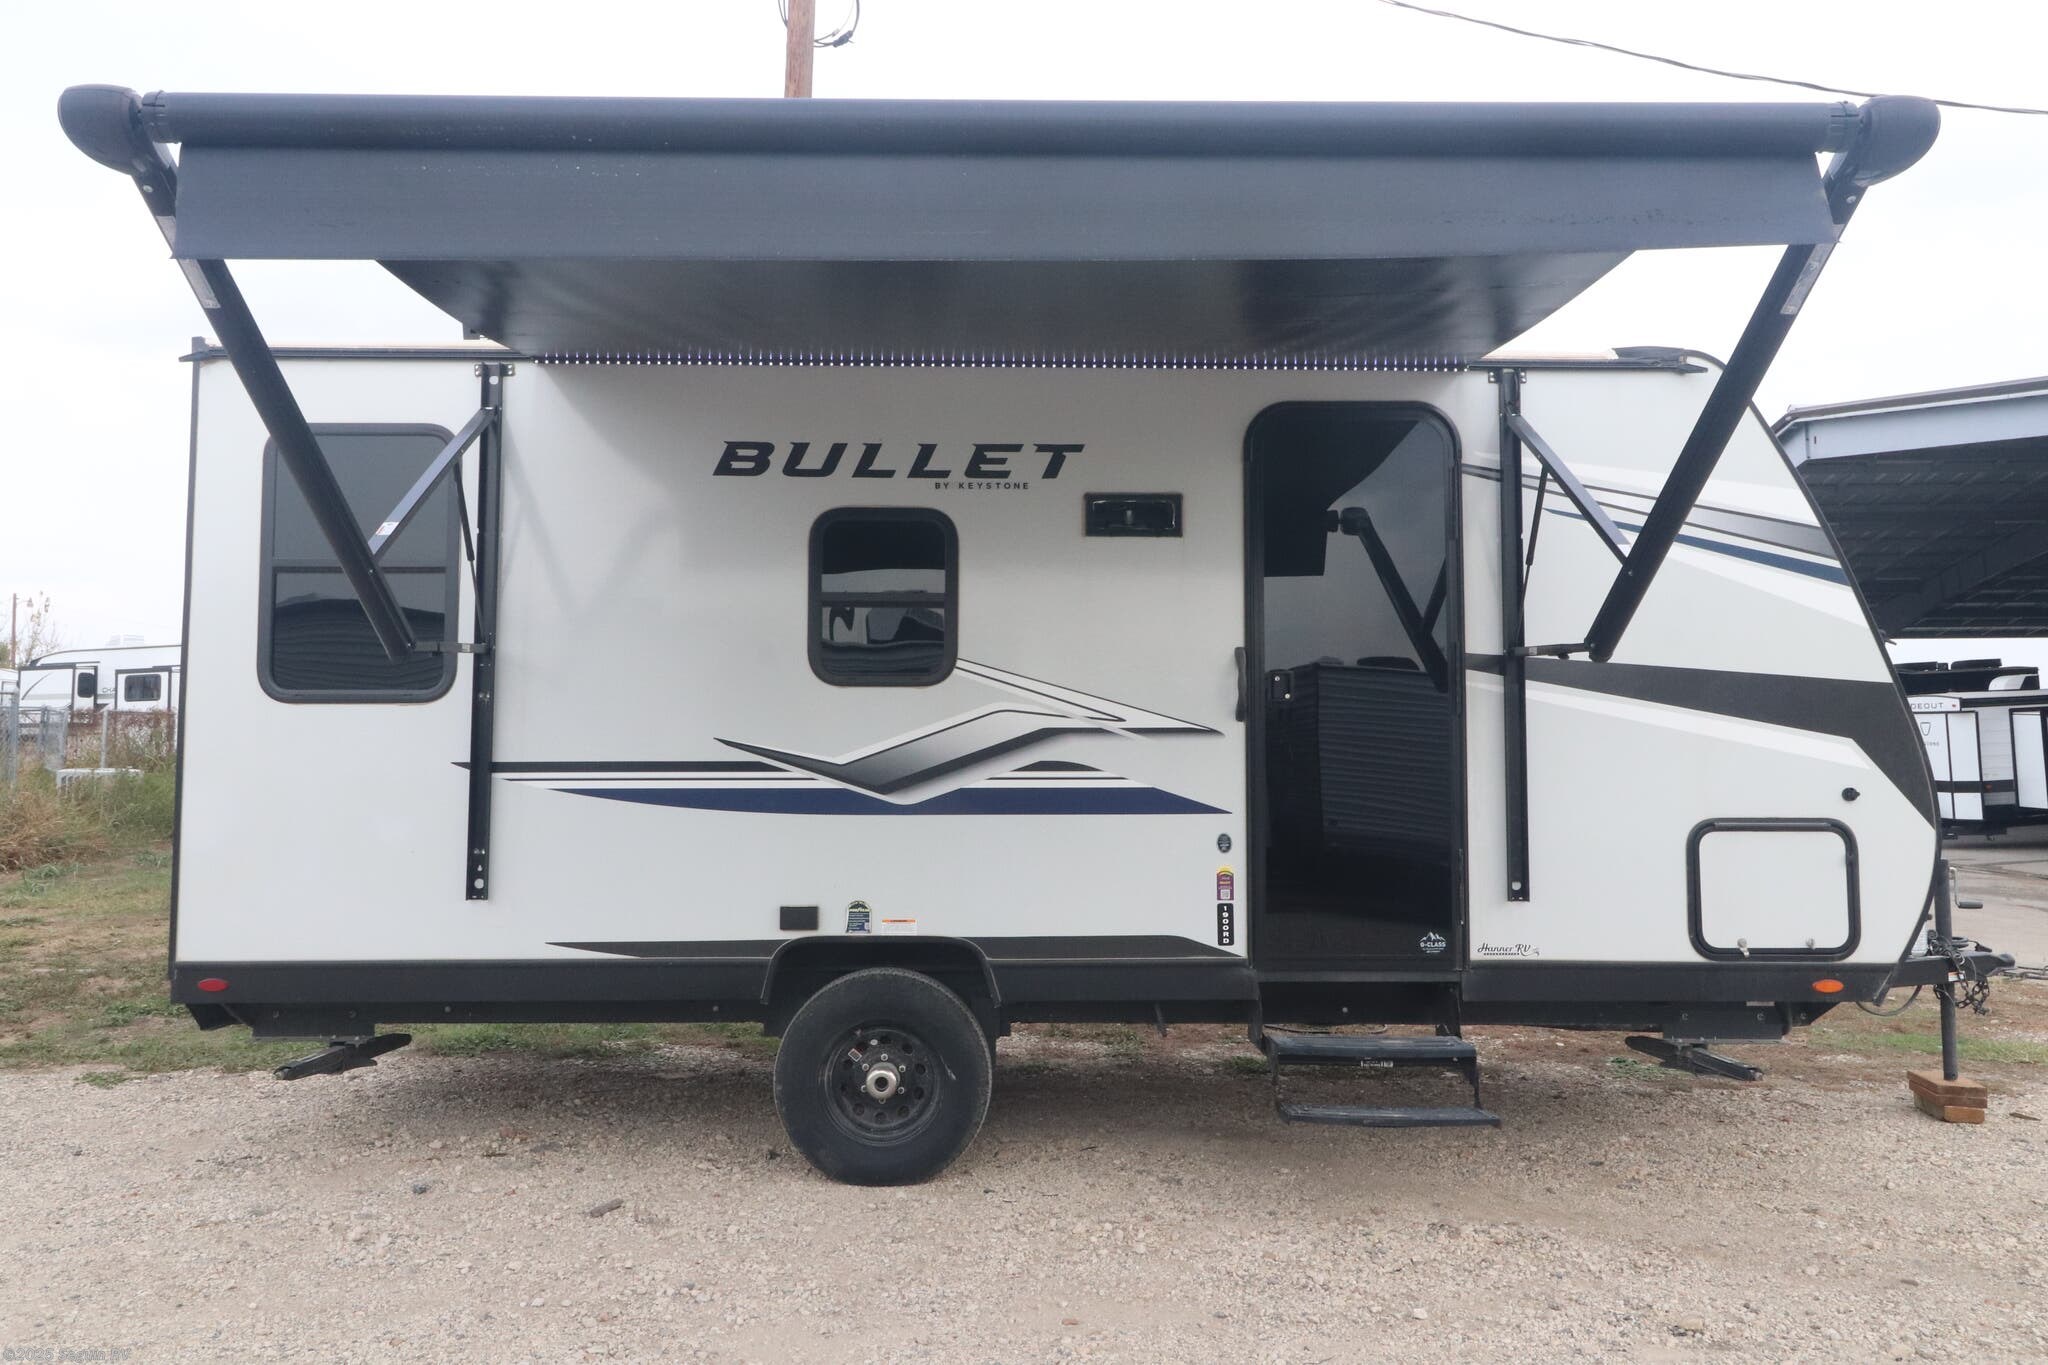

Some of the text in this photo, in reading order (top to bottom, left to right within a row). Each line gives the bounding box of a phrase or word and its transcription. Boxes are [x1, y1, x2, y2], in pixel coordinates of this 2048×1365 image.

[712, 440, 1085, 479] BULLET
[934, 481, 1030, 490] BY KEYSTONE
